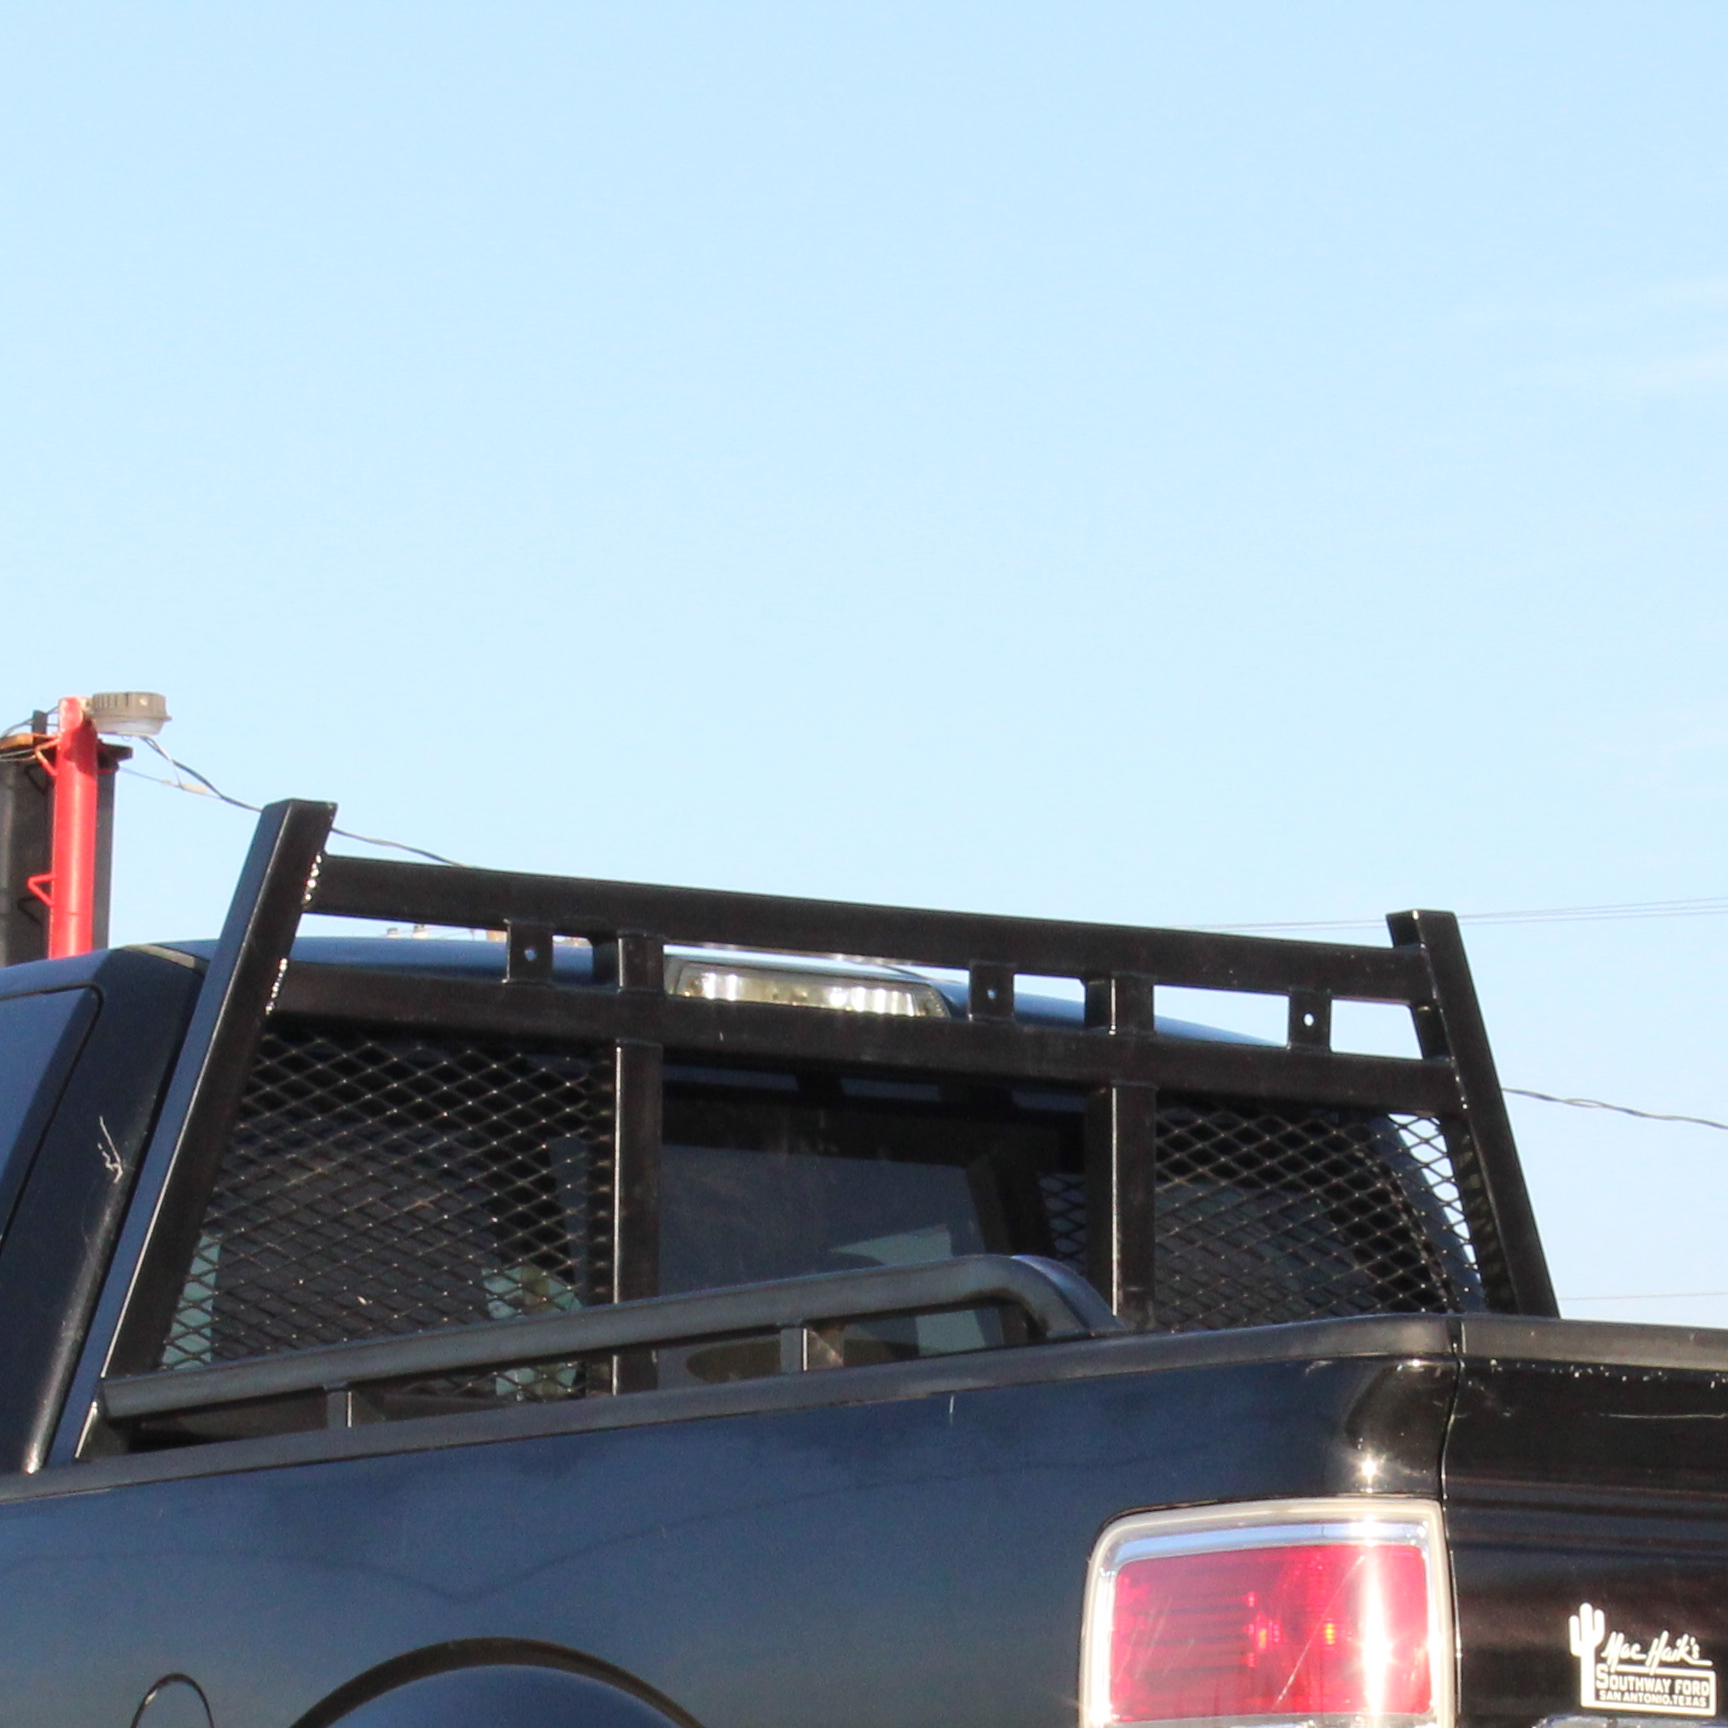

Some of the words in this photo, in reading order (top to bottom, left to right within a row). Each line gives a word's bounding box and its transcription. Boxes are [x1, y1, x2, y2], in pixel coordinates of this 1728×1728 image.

[1600, 1630, 1647, 1672] Mac
[1596, 1666, 1672, 1692] SOUTHWAY
[1674, 1680, 1709, 1697] FORD
[1599, 1690, 1622, 1702] SAN
[1673, 1695, 1707, 1708] TEXAS
